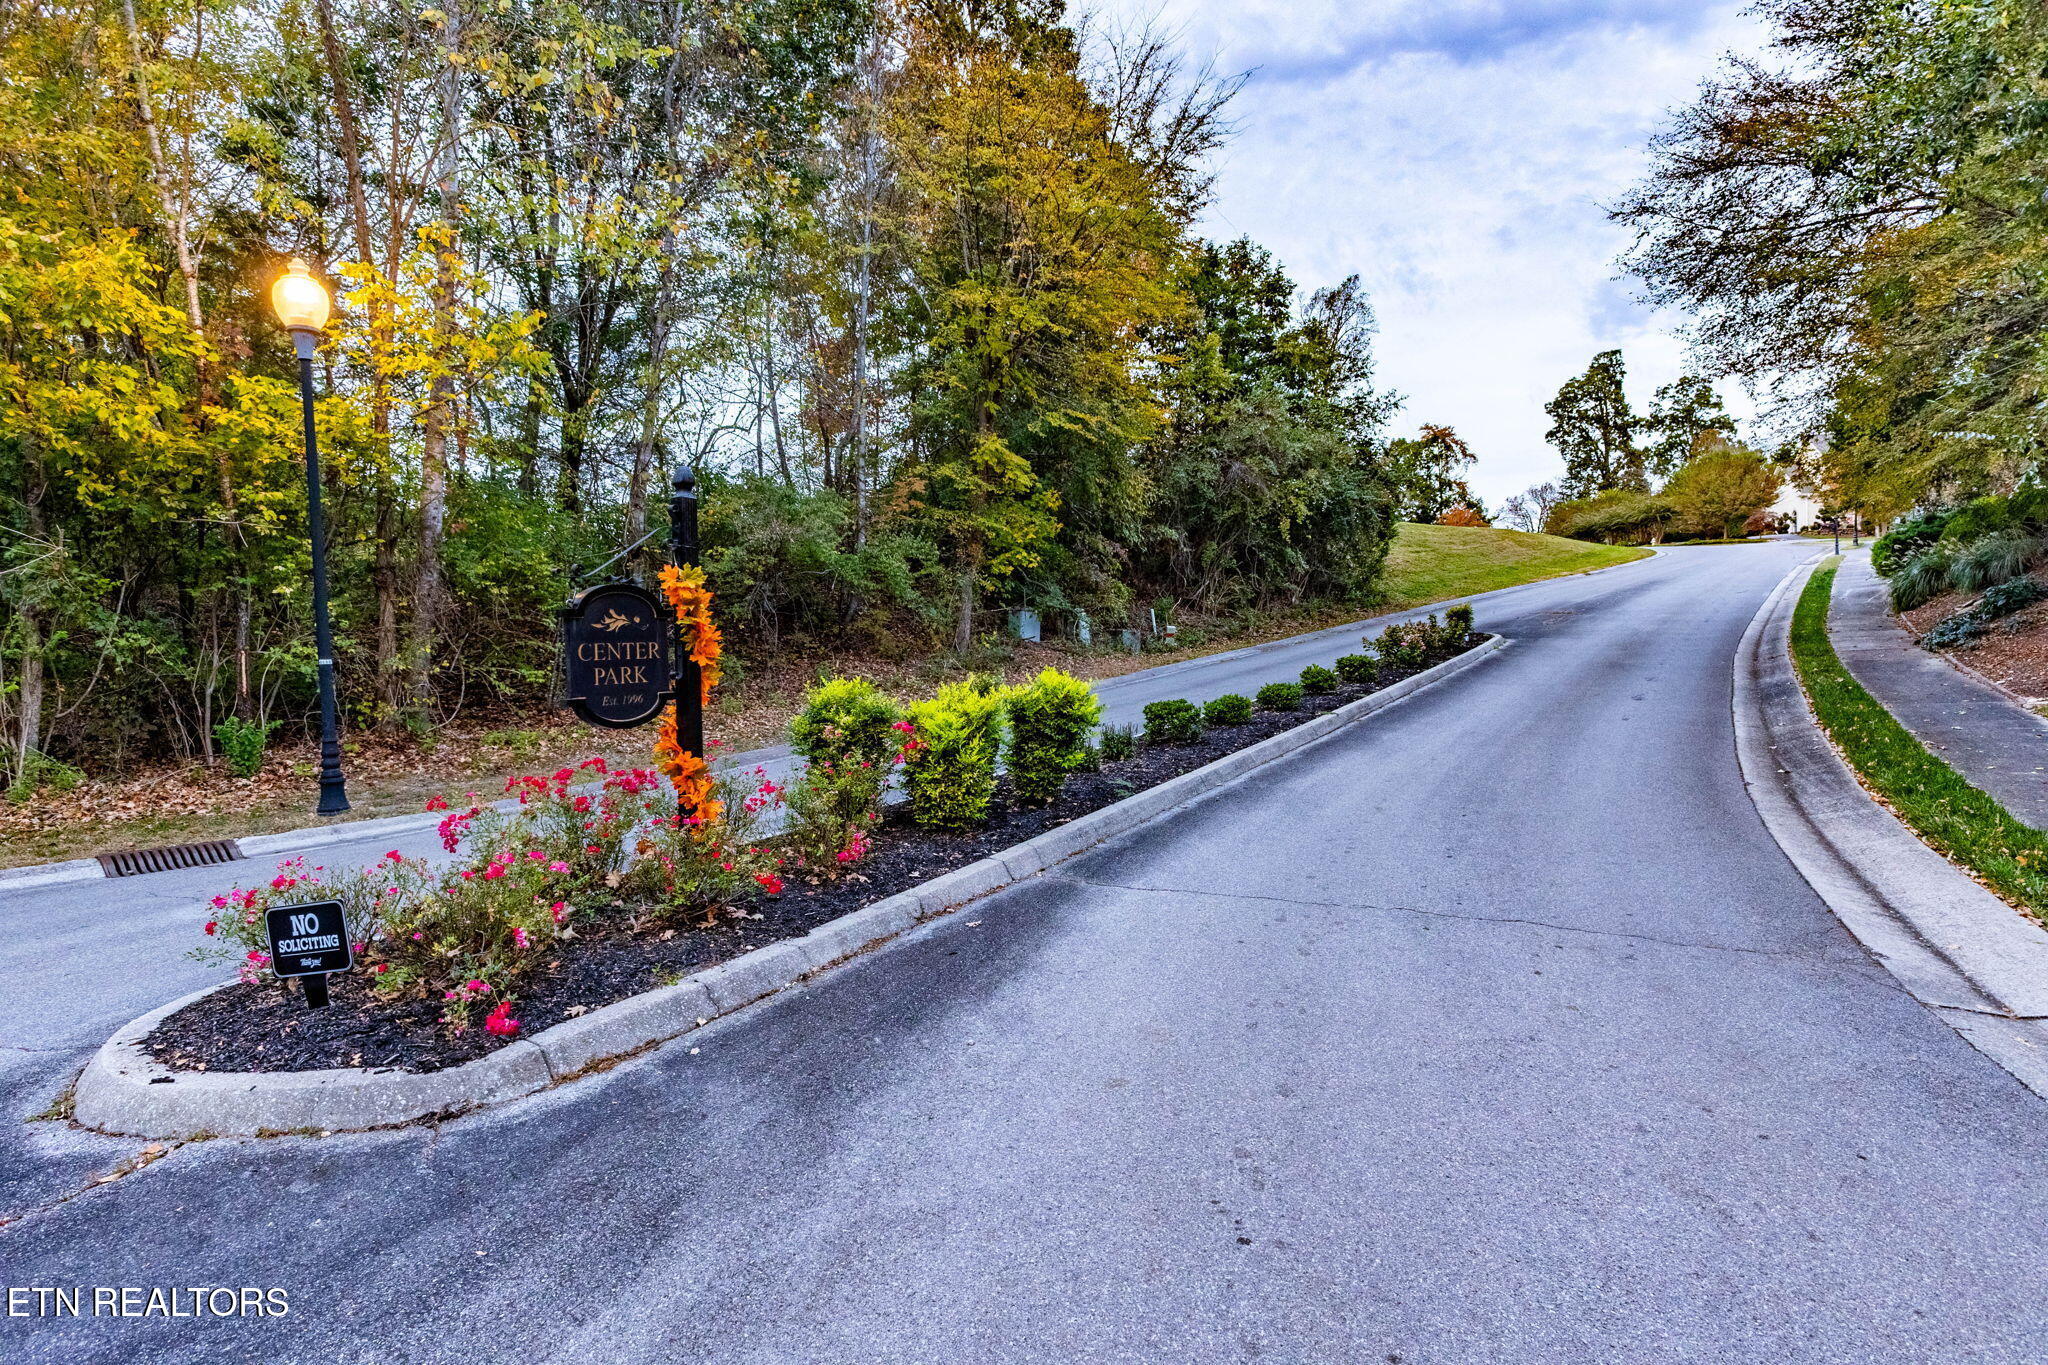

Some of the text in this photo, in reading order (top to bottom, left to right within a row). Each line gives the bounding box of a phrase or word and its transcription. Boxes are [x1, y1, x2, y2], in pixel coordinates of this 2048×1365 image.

[577, 641, 661, 662] CENTER
[593, 665, 649, 686] PARK
[622, 694, 644, 705] 1996
[290, 912, 319, 936] NO
[278, 934, 340, 953] SOLICITING
